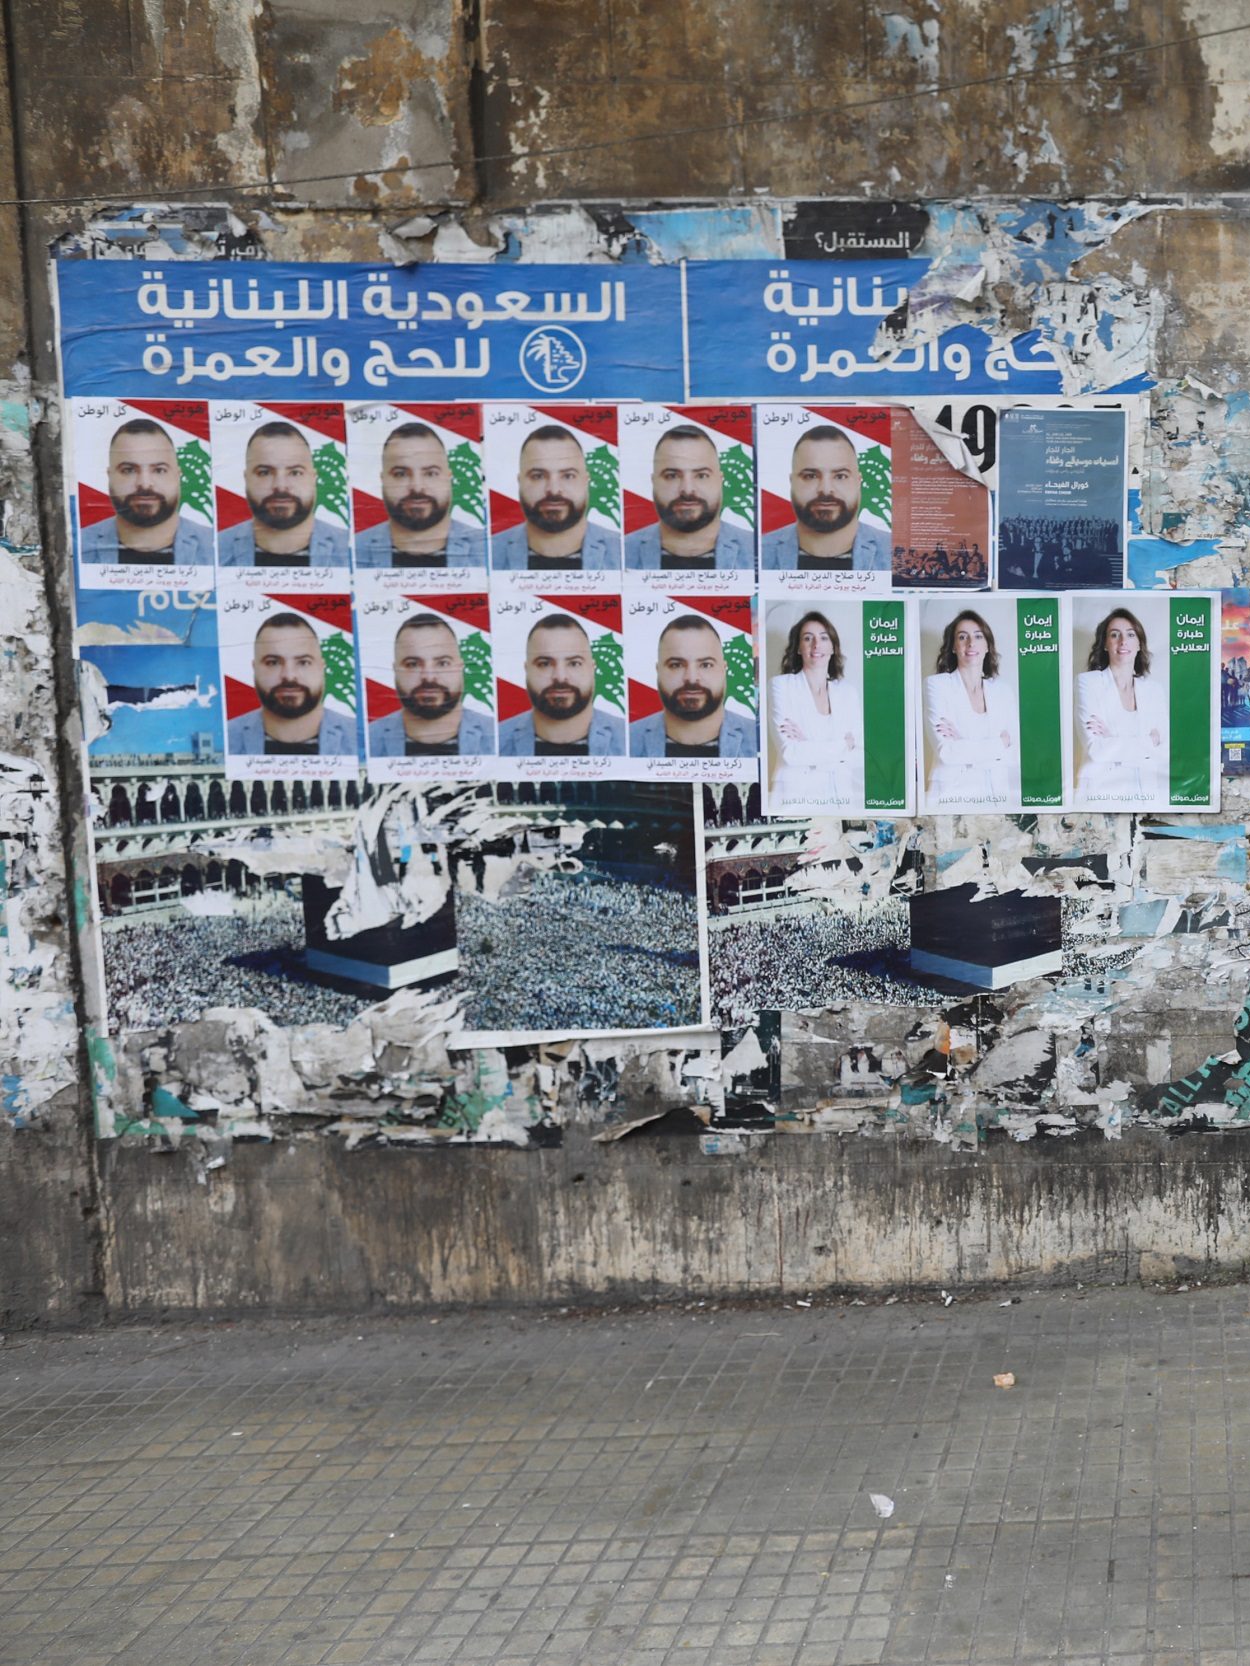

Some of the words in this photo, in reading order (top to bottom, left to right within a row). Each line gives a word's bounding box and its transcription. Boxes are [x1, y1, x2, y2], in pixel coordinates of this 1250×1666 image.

[813, 230, 910, 253] المستقبل؟
[136, 270, 348, 329] اللبنانية
[362, 271, 626, 330] السعودية
[141, 334, 350, 386] والعمرة
[363, 336, 491, 385] للحج
[985, 341, 1060, 381] حج
[78, 405, 109, 418] الوطن
[113, 404, 127, 418] كل
[215, 408, 246, 421] الوطن
[250, 408, 264, 420] كل
[385, 409, 399, 422] كل
[489, 412, 520, 425] الوطن
[524, 412, 538, 424] كل
[624, 412, 654, 426] الوطن
[658, 412, 672, 424] كل
[763, 412, 793, 426] الوطن
[797, 412, 811, 424] كل
[224, 600, 254, 613] الوطن
[258, 598, 272, 611] كل
[363, 602, 393, 615] الوطن
[397, 600, 410, 613] كل
[497, 602, 526, 614] الوطن
[530, 600, 544, 613] كل
[629, 602, 658, 615] الوطن
[662, 602, 676, 614] كل
[869, 617, 898, 630] إيمان
[1024, 614, 1052, 628] إيمان
[1176, 614, 1205, 626] إيمان
[870, 633, 898, 642] طبارة
[1025, 630, 1052, 640] طبارة
[1177, 630, 1204, 638] طبارة
[864, 647, 904, 658] العلايلي
[1019, 644, 1058, 656] العلايلي
[1171, 644, 1210, 655] العلايلي
